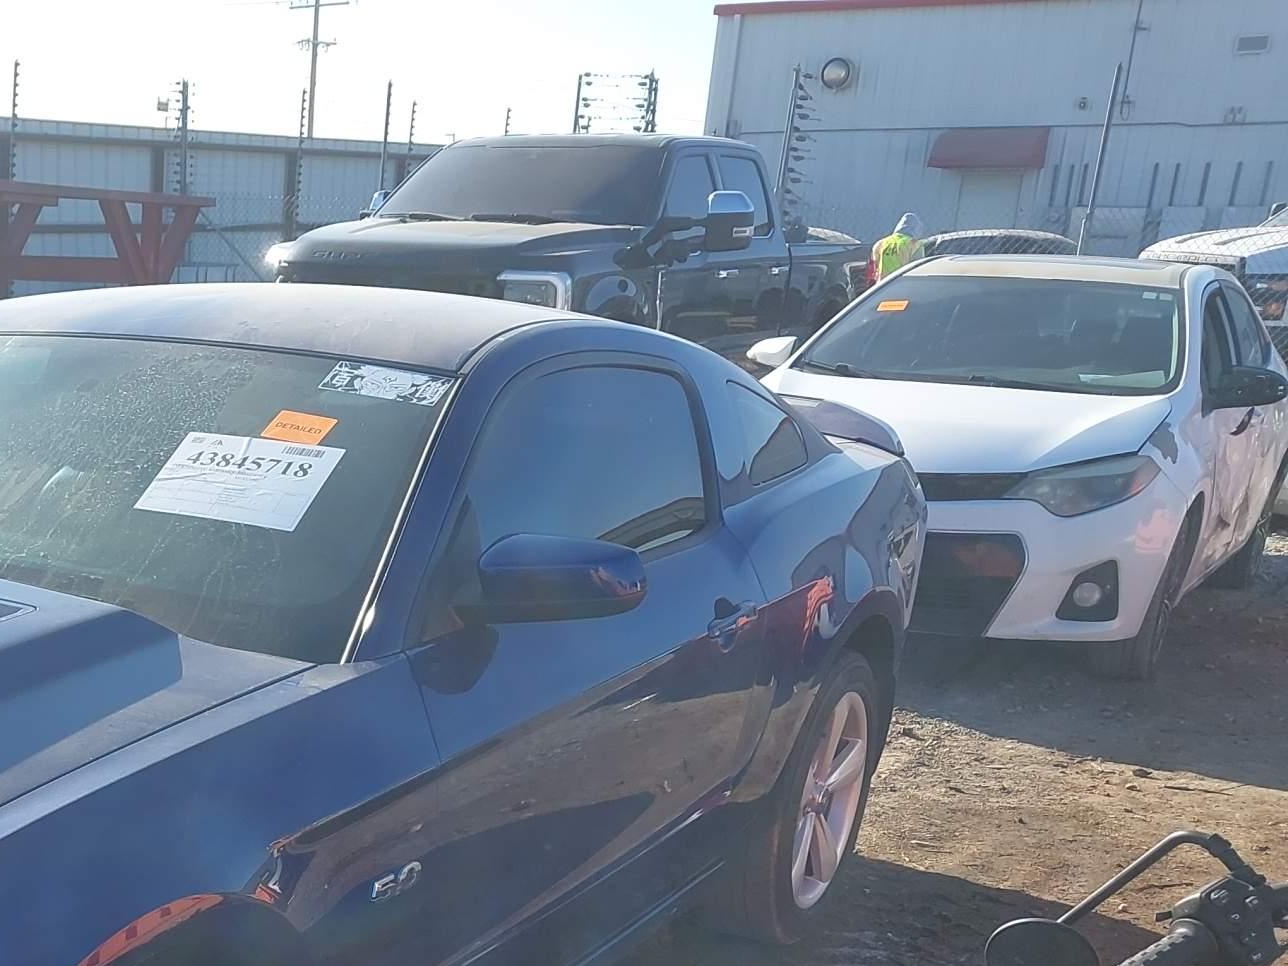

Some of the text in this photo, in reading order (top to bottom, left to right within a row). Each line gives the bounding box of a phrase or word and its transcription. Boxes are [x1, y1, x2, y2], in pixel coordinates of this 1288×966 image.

[274, 421, 323, 435] DETAILED
[186, 450, 313, 478] 43845718
[371, 861, 422, 902] 5.0
